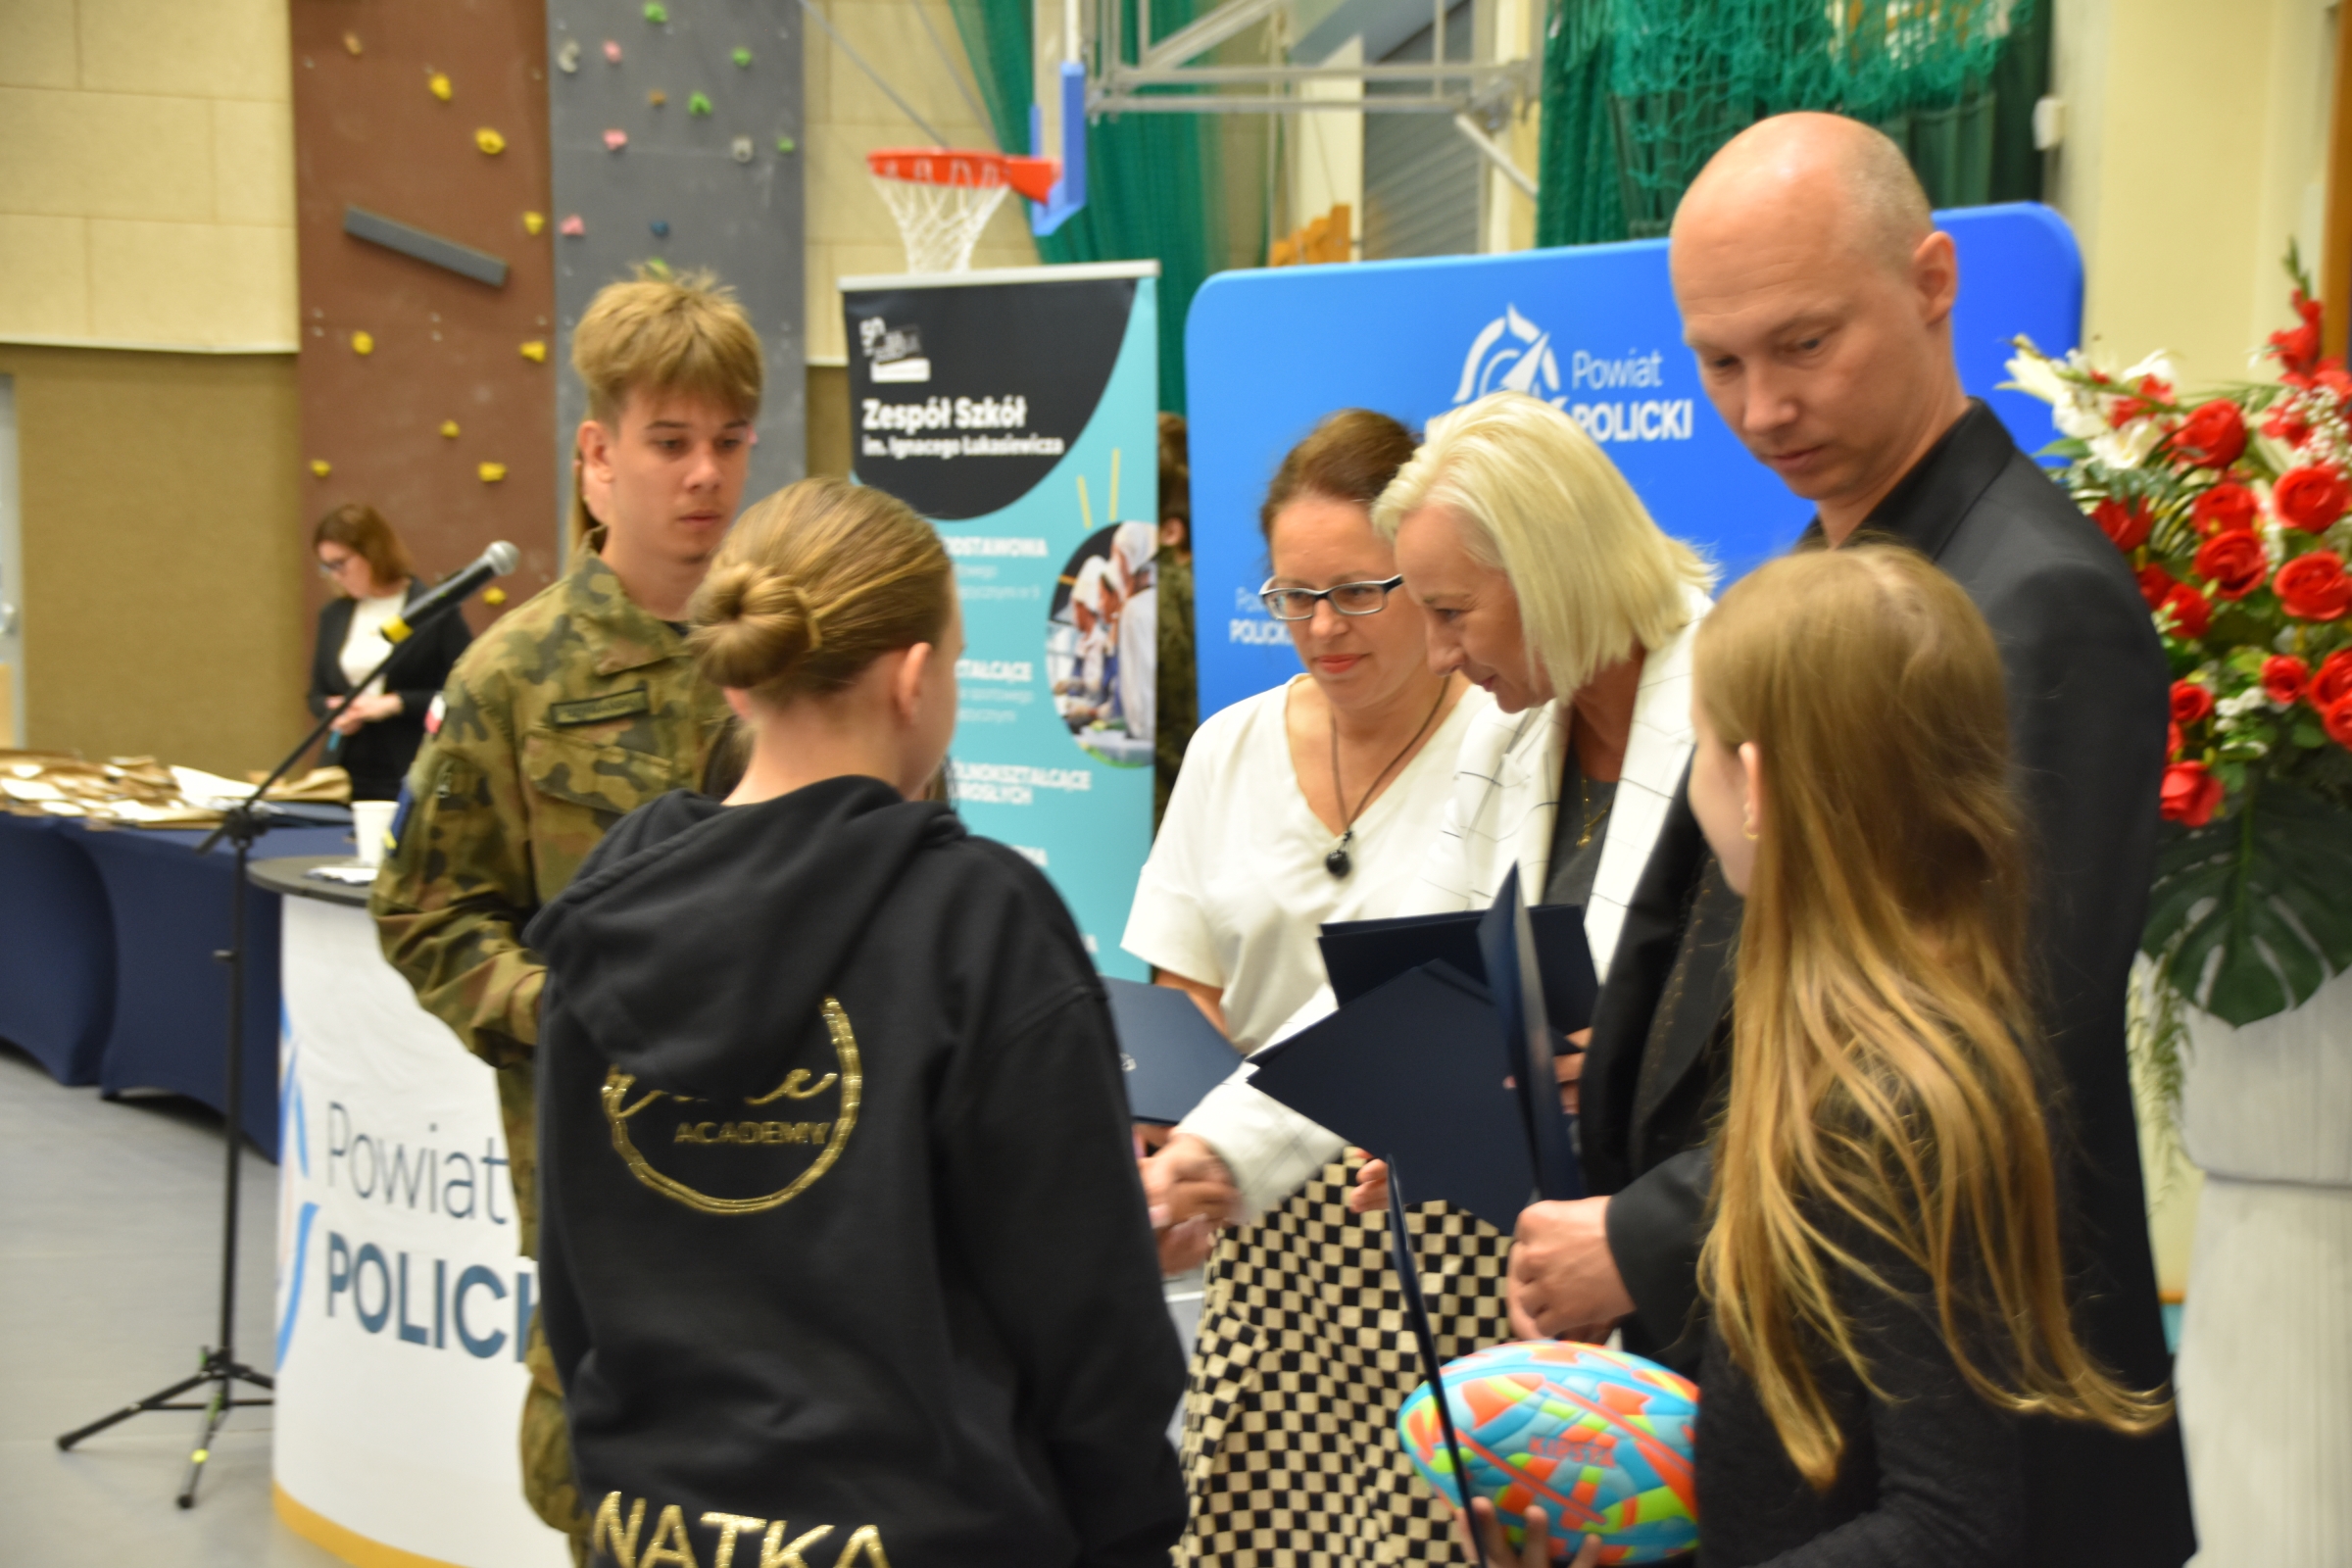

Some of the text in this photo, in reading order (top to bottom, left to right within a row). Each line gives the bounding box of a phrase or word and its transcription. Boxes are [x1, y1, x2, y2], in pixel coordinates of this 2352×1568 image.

[1572, 347, 1663, 390] Powiat
[861, 394, 1027, 436] Zespół Szkół
[1572, 399, 1693, 442] POLICKI
[861, 434, 887, 457] im.
[673, 1121, 831, 1145] ACADEMY
[326, 1101, 509, 1225] Powiat
[1529, 1436, 1616, 1469] KIPSTA
[593, 1491, 892, 1568] NATKA
